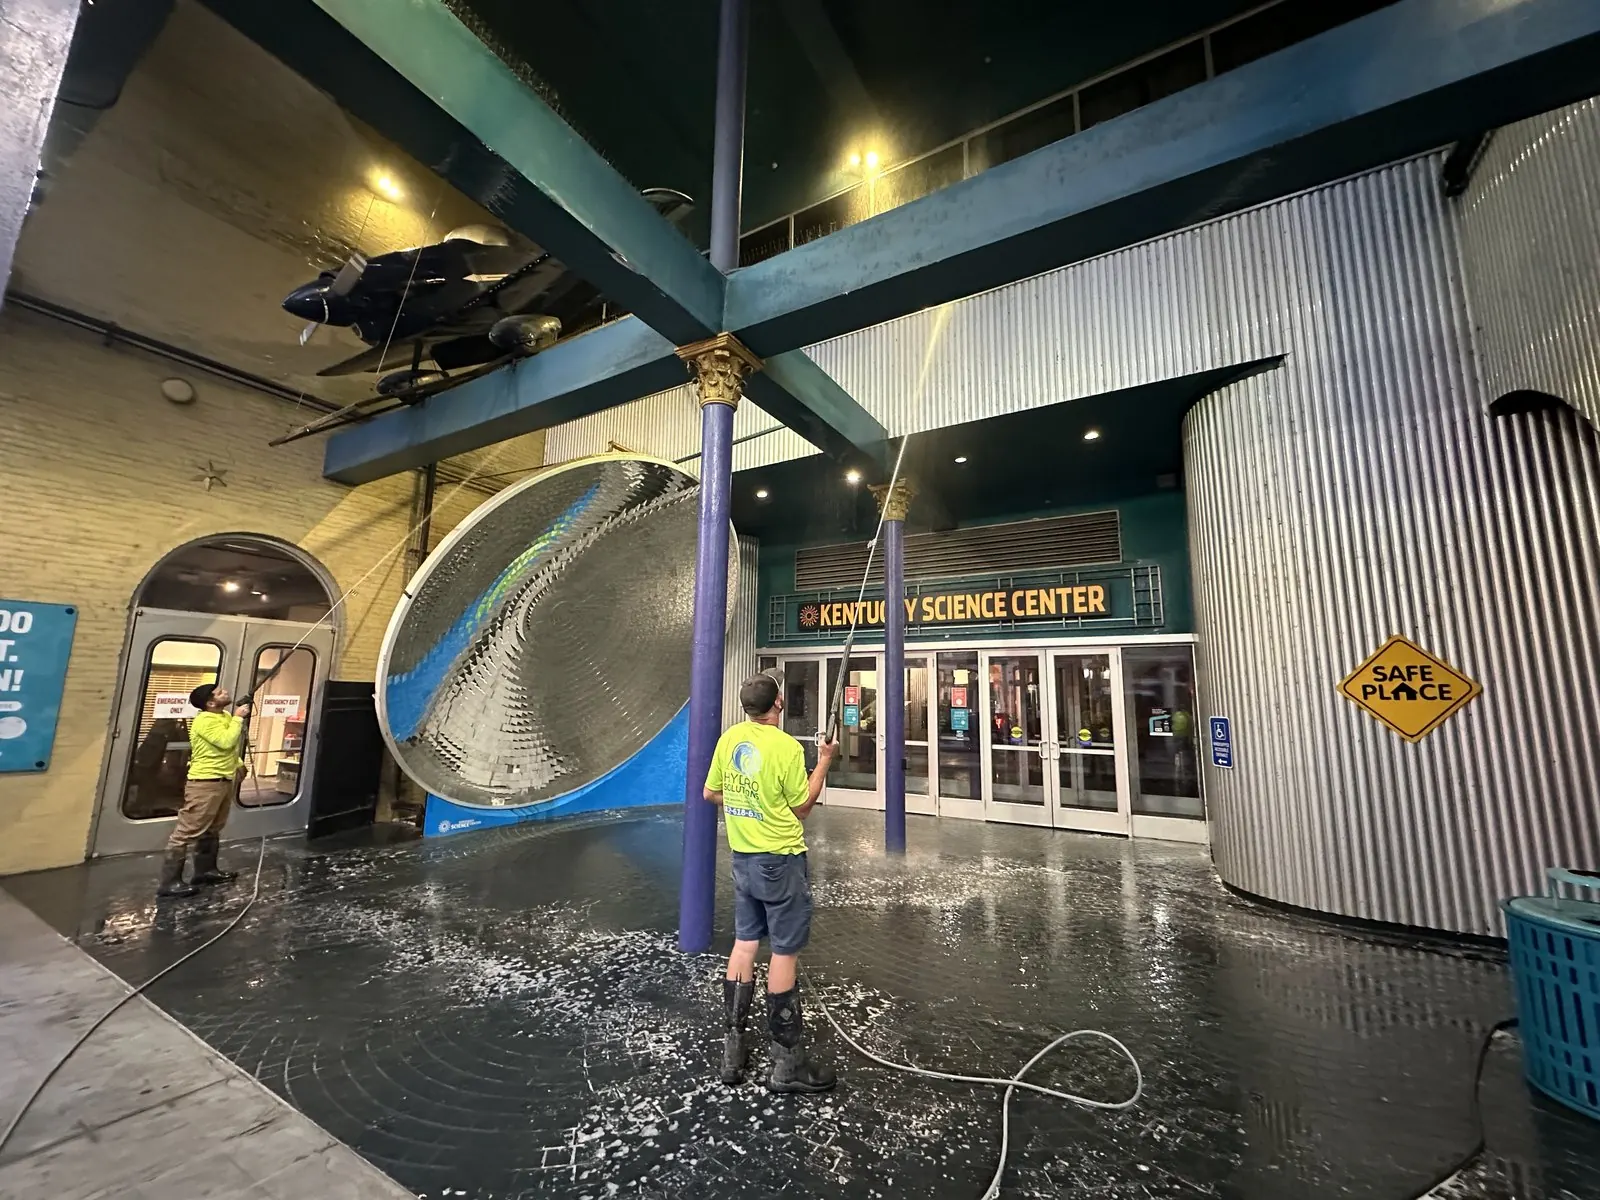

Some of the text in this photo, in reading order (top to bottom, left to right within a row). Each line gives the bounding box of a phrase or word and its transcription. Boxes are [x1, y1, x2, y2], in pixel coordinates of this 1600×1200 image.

[922, 591, 1007, 622] SCIENCE
[1011, 585, 1106, 616] CENTER
[1372, 665, 1434, 682] SAFE
[157, 697, 187, 705] EMERGENCY
[264, 698, 299, 706] EMERGENCY EXIT
[274, 706, 286, 714] ONLY
